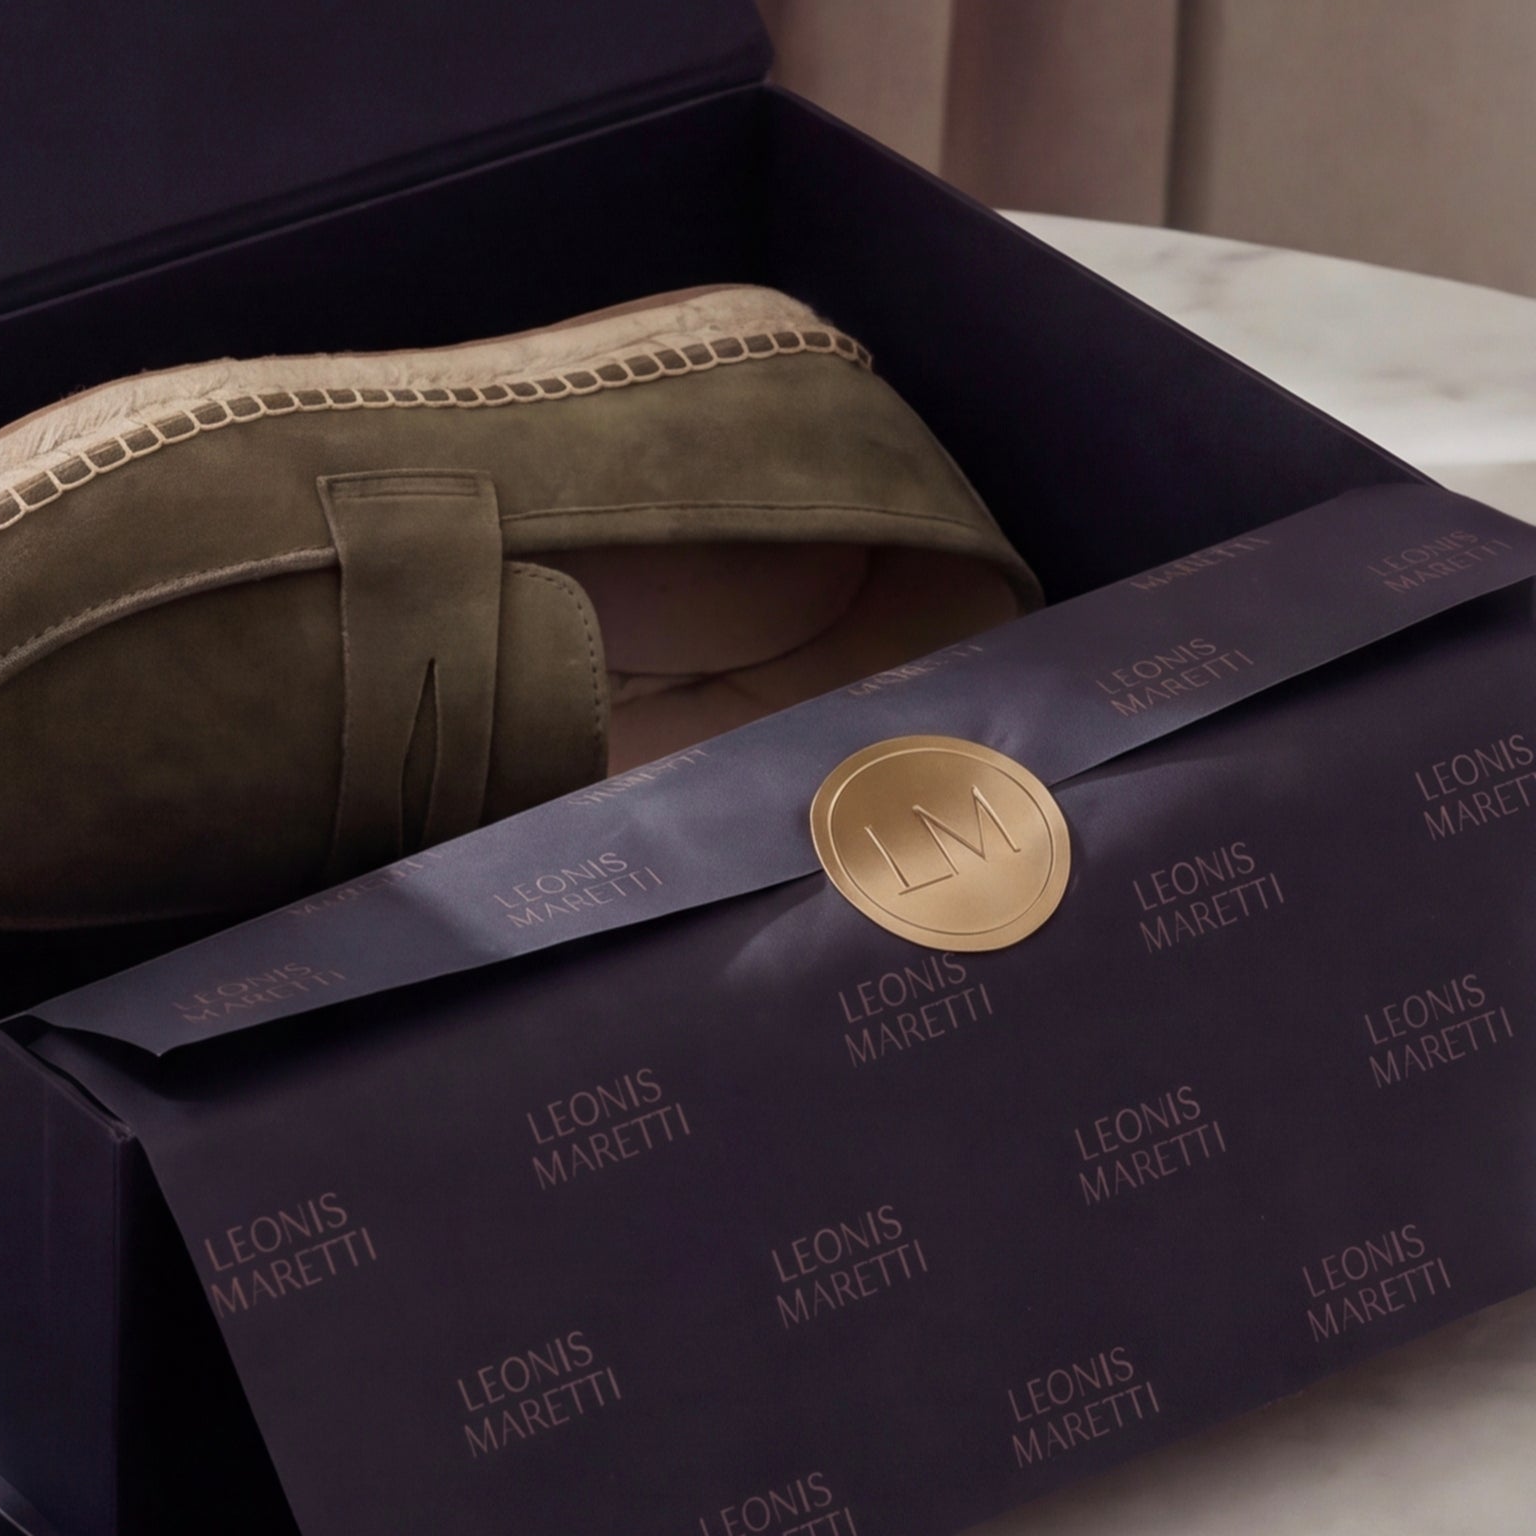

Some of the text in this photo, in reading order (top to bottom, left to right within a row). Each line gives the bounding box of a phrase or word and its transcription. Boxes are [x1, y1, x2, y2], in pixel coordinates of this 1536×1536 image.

[1367, 530, 1479, 577] LEONIS
[1383, 539, 1513, 593] MARETTI
[1096, 638, 1216, 694] LEONIS
[1111, 650, 1254, 716] MARETTI
[1415, 734, 1535, 800] LEONIS
[1424, 771, 1536, 840] MARET
[863, 785, 1022, 895] LM
[1132, 841, 1256, 913] LEONIS
[494, 852, 628, 909] LEONIS
[507, 866, 663, 928] MARETTI
[1138, 873, 1285, 953] MARETTI
[173, 963, 311, 1011] LEONIS
[838, 952, 967, 1024] LEONIS
[1363, 974, 1487, 1046] LEONIS
[844, 983, 993, 1069] MARETTI
[1368, 1007, 1515, 1088] MARETTI
[526, 1068, 663, 1145] LEONIS
[1074, 1085, 1202, 1161] LEONIS
[531, 1102, 691, 1191] MARETTI
[1078, 1121, 1228, 1207] MARETTI
[203, 1192, 349, 1273] LEONIS
[771, 1205, 904, 1285] LEONIS
[1301, 1224, 1426, 1300] LEONIS
[209, 1227, 377, 1319] MARETTI
[775, 1239, 928, 1330] MARETTI
[1305, 1258, 1452, 1344] MARETTI
[457, 1331, 594, 1413] LEONIS
[1006, 1346, 1135, 1424] LEONIS
[464, 1366, 622, 1458] MARETTI
[1011, 1382, 1161, 1468] MARETTI
